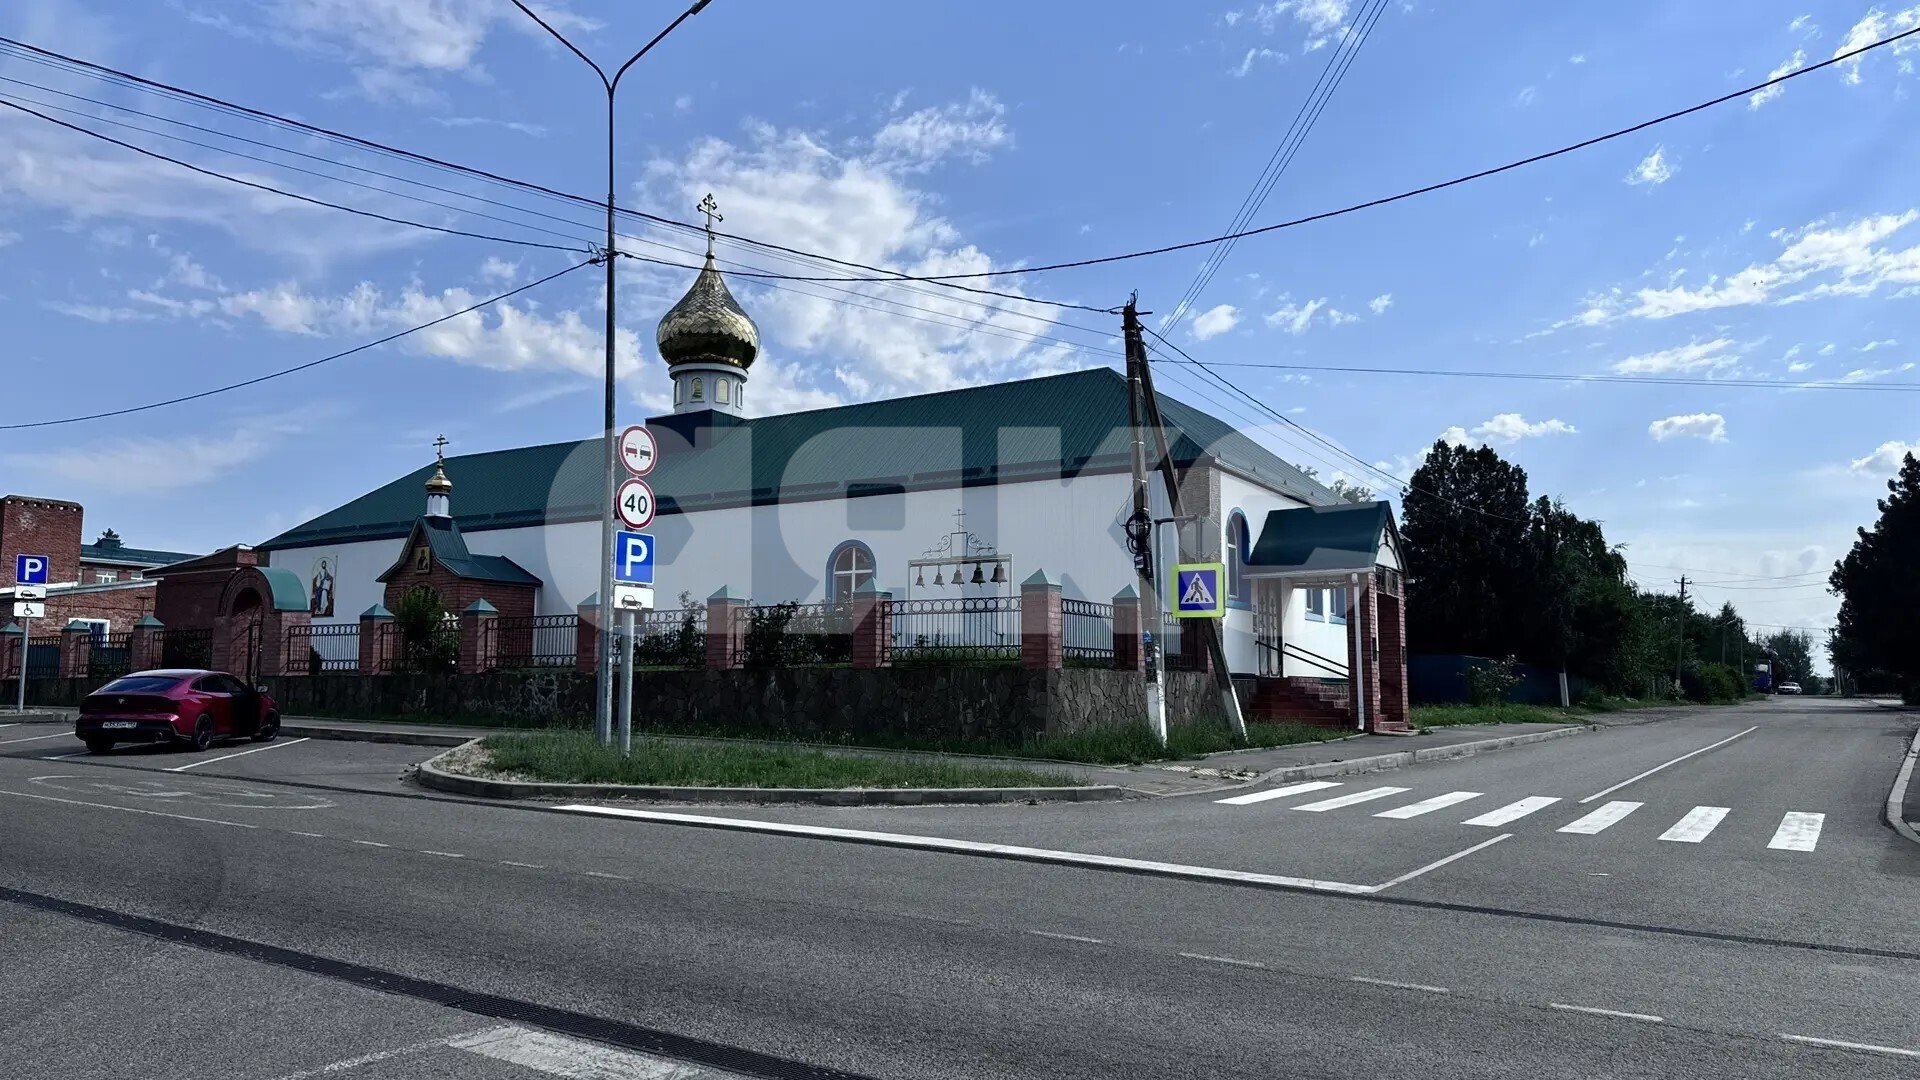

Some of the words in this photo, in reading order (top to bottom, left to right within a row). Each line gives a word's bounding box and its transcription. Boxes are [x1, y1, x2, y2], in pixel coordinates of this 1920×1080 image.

[624, 493, 648, 515] 40
[625, 537, 648, 577] P
[24, 558, 43, 581] P
